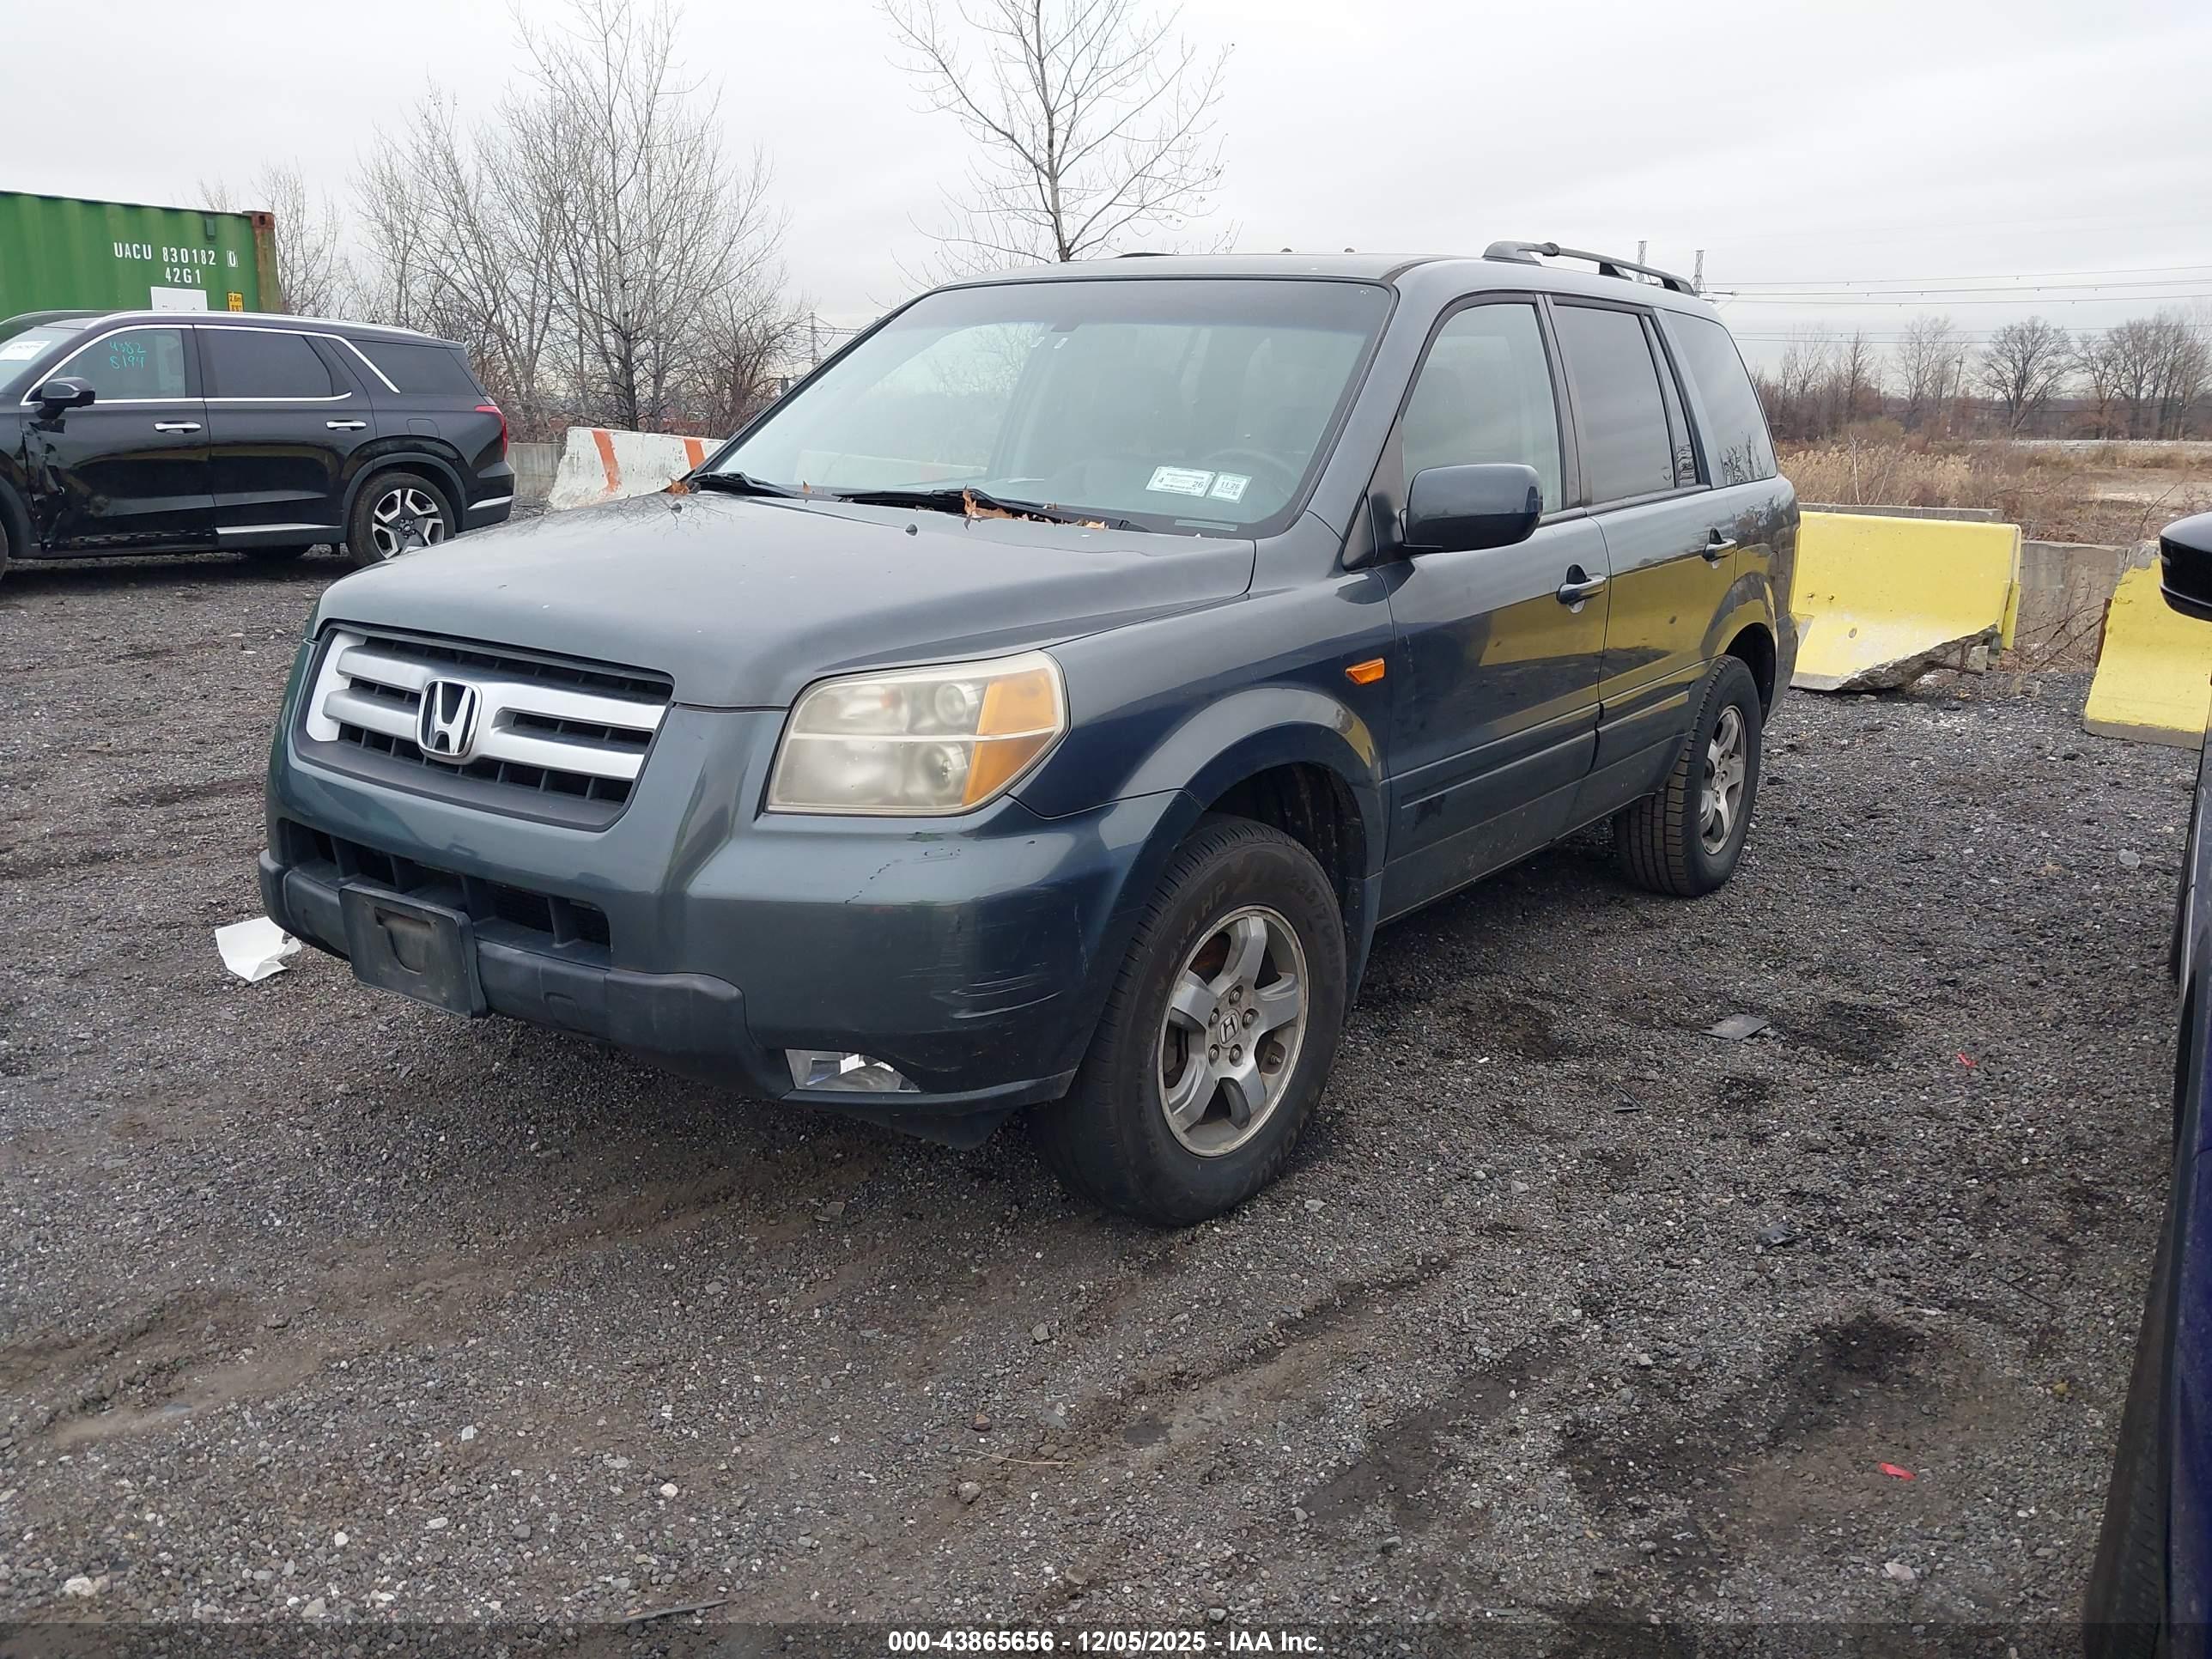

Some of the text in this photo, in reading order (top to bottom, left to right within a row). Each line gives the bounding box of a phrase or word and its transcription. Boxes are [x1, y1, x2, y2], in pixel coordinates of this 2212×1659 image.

[113, 241, 153, 260] UACU
[161, 246, 216, 266] 830182
[165, 266, 201, 284] 42G1
